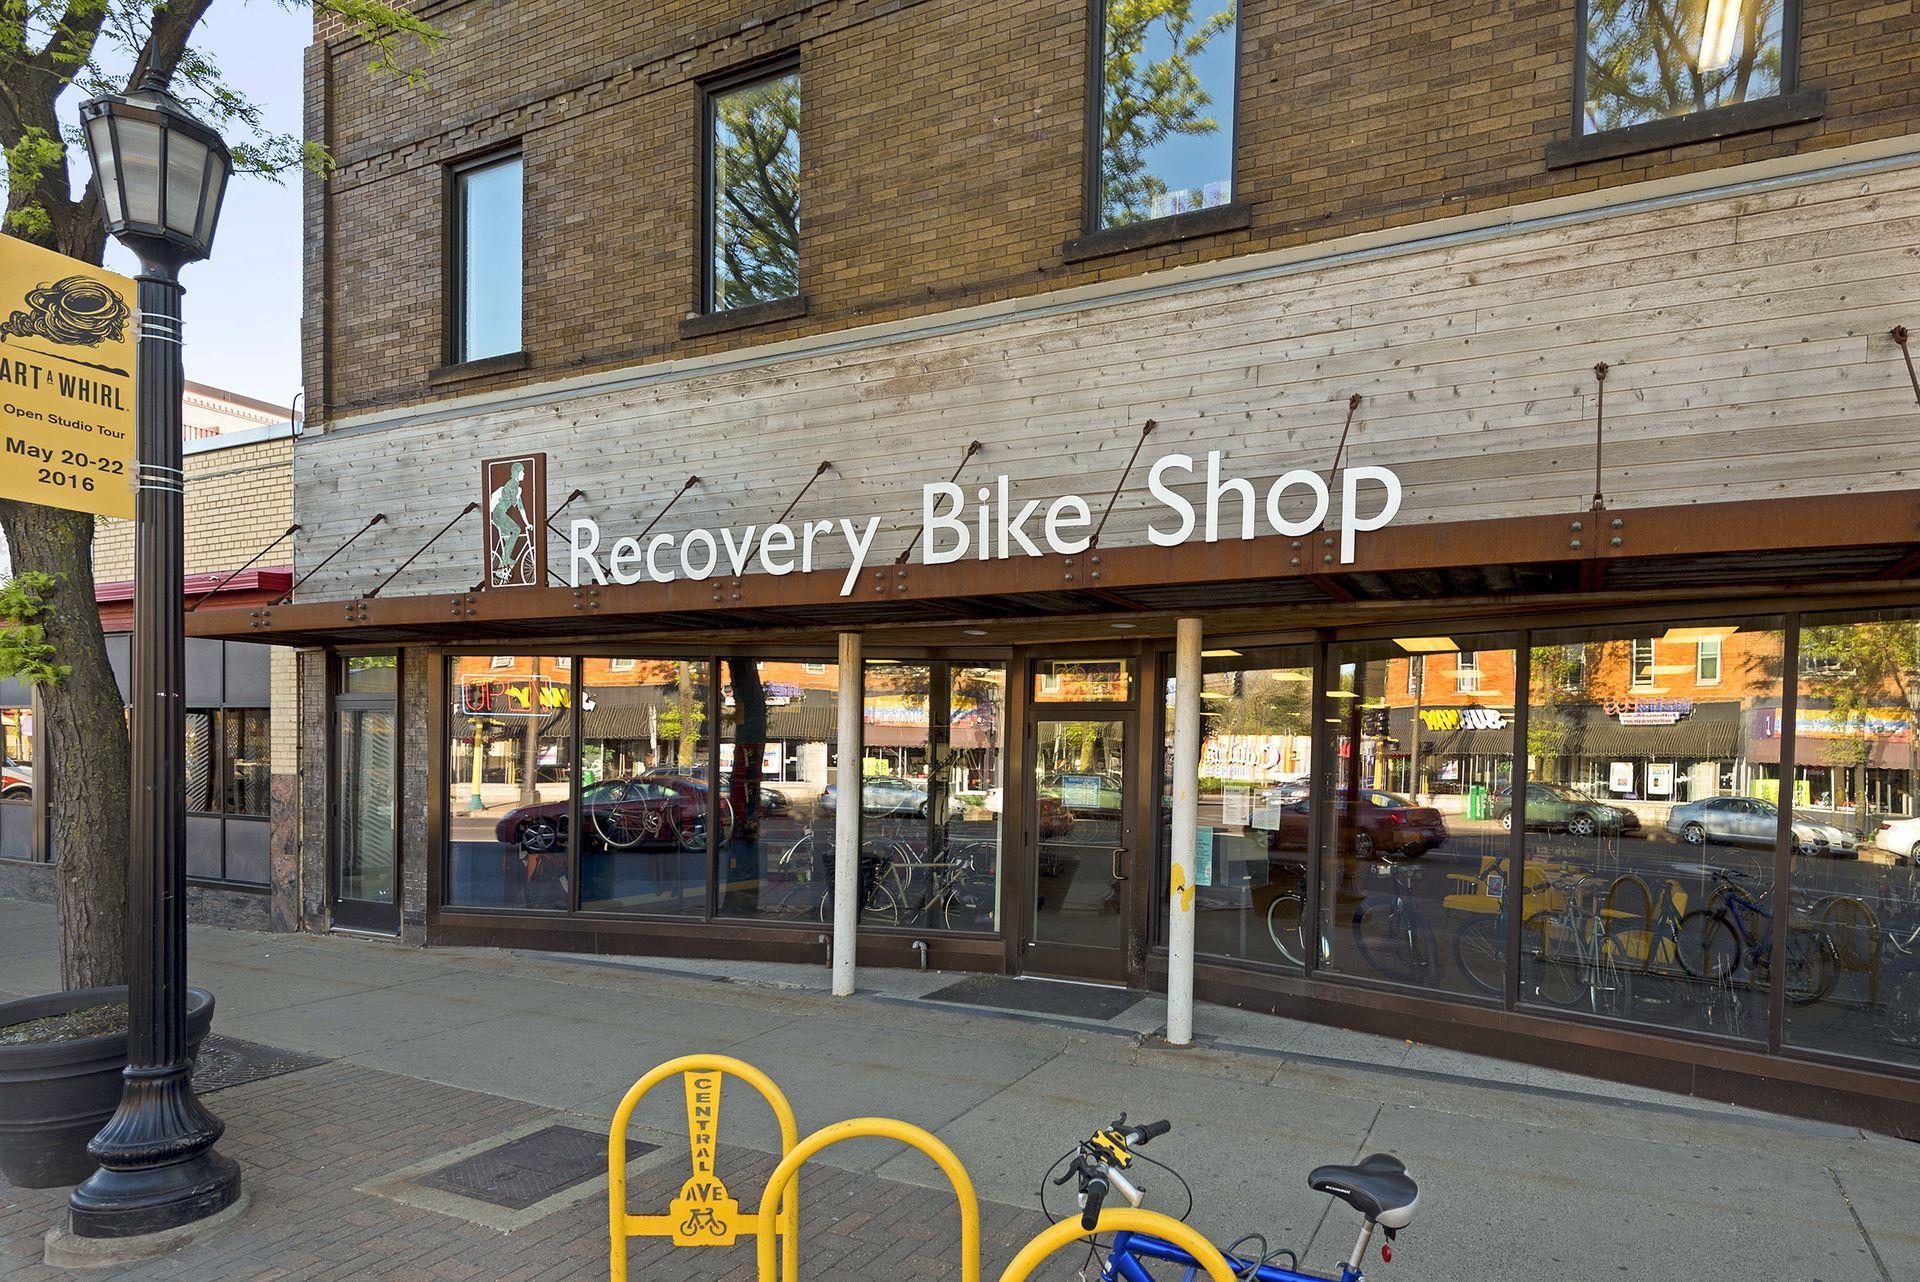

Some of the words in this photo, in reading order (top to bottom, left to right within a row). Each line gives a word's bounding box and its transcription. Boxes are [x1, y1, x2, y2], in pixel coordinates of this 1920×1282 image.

[0, 357, 42, 390] ART
[46, 370, 54, 384] A
[58, 372, 125, 411] WHIRL
[3, 403, 43, 421] Open
[48, 413, 93, 432] Studio
[97, 424, 126, 440] Tour
[6, 436, 54, 463] May
[61, 449, 124, 475] 20-22
[38, 468, 95, 492] 2016
[570, 516, 882, 597] Recovery
[923, 474, 1091, 565] Bike
[1147, 450, 1402, 564] Shop
[694, 1078, 712, 1171] CENTRAL
[686, 1183, 722, 1202] AVE
